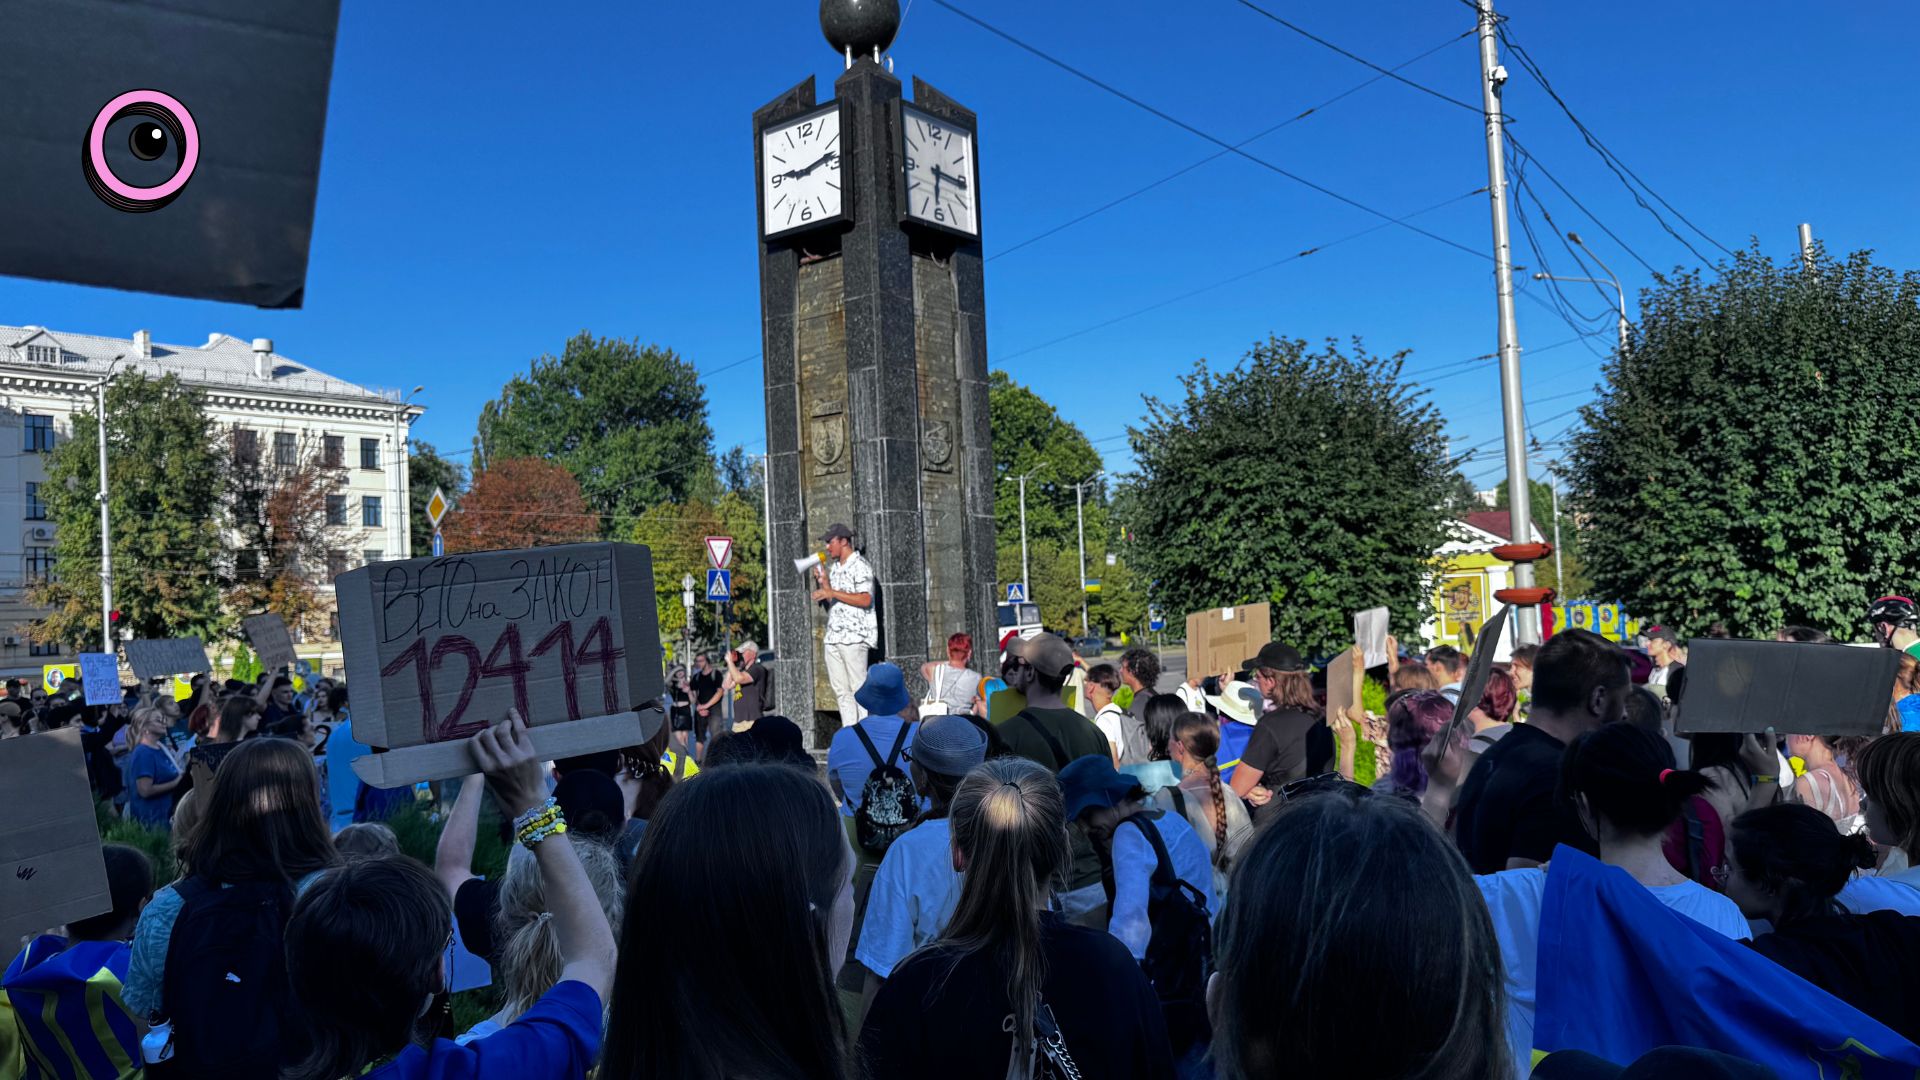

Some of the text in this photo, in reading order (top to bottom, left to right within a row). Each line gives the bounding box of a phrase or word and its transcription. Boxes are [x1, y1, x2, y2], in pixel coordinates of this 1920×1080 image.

[796, 122, 813, 138] 12
[927, 123, 942, 141] 12
[771, 174, 783, 188] 9
[800, 207, 813, 222] 6
[934, 207, 945, 222] 6
[381, 549, 613, 644] ВЕТО на ЗАКОН
[380, 615, 627, 744] 12414
